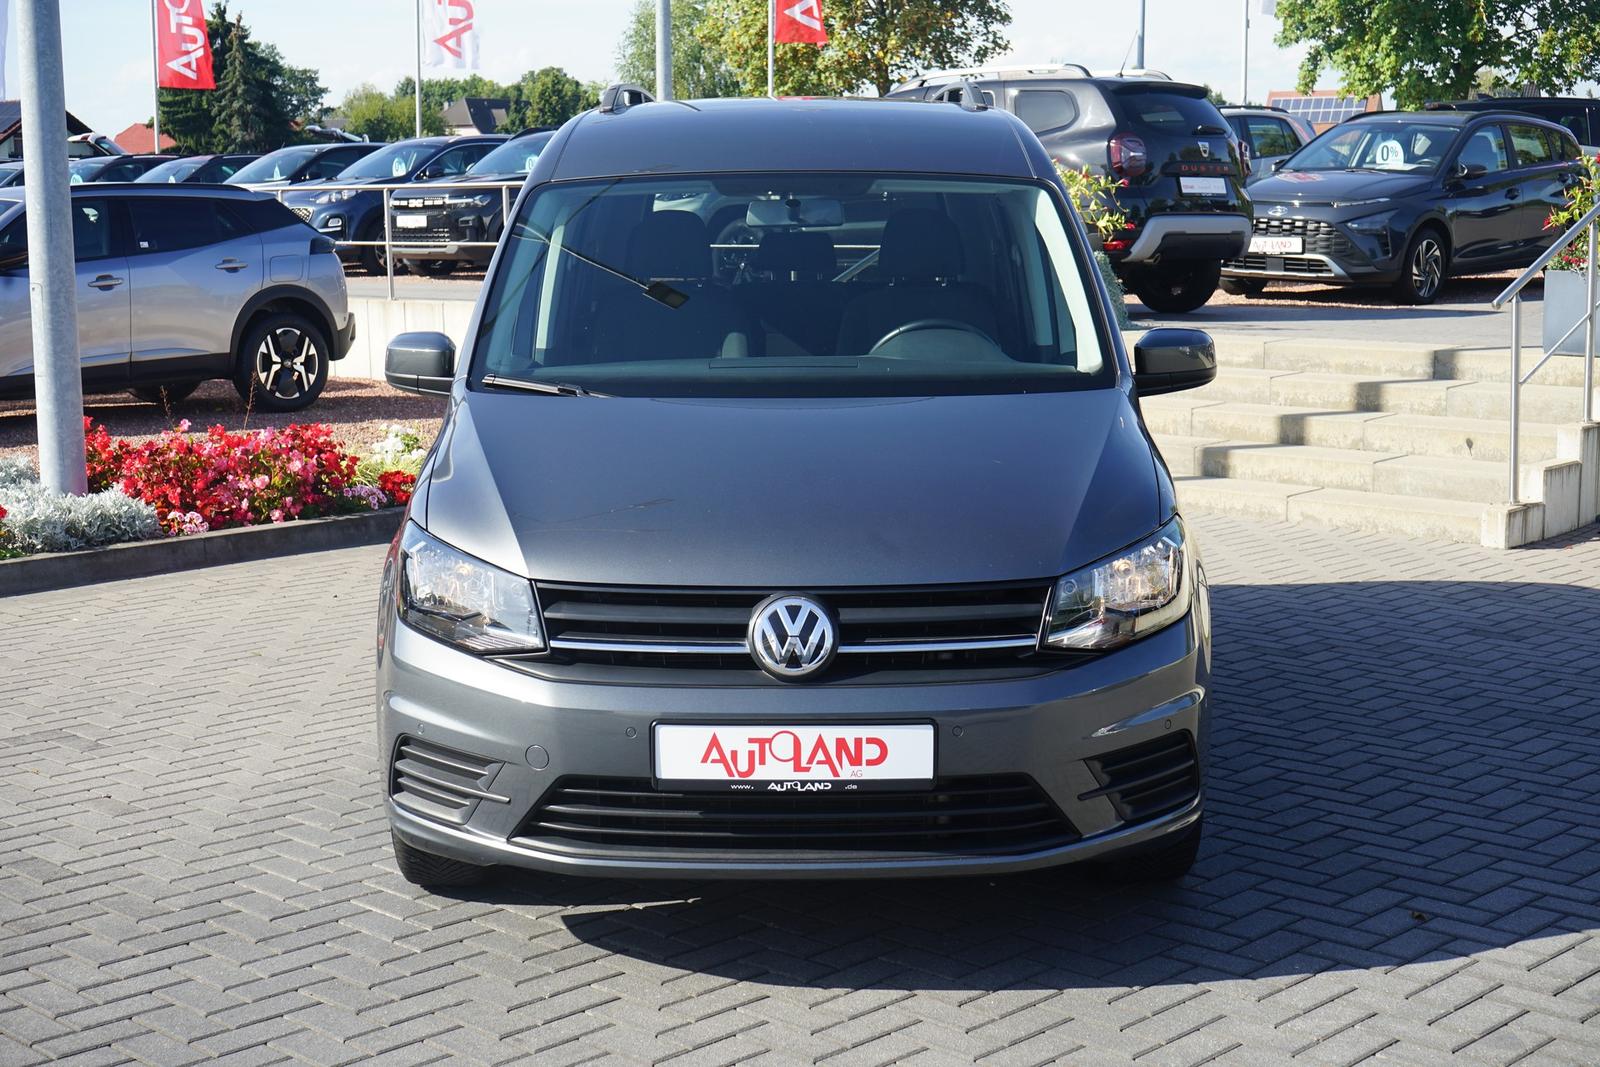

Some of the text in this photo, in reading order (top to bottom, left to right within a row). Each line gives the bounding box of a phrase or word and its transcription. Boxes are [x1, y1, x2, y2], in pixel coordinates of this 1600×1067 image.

[1381, 145, 1398, 161] 0%
[1181, 163, 1229, 172] DUSTER
[701, 730, 889, 778] AUTOLAND
[850, 770, 863, 778] AG
[767, 781, 832, 791] AUTOLAND
